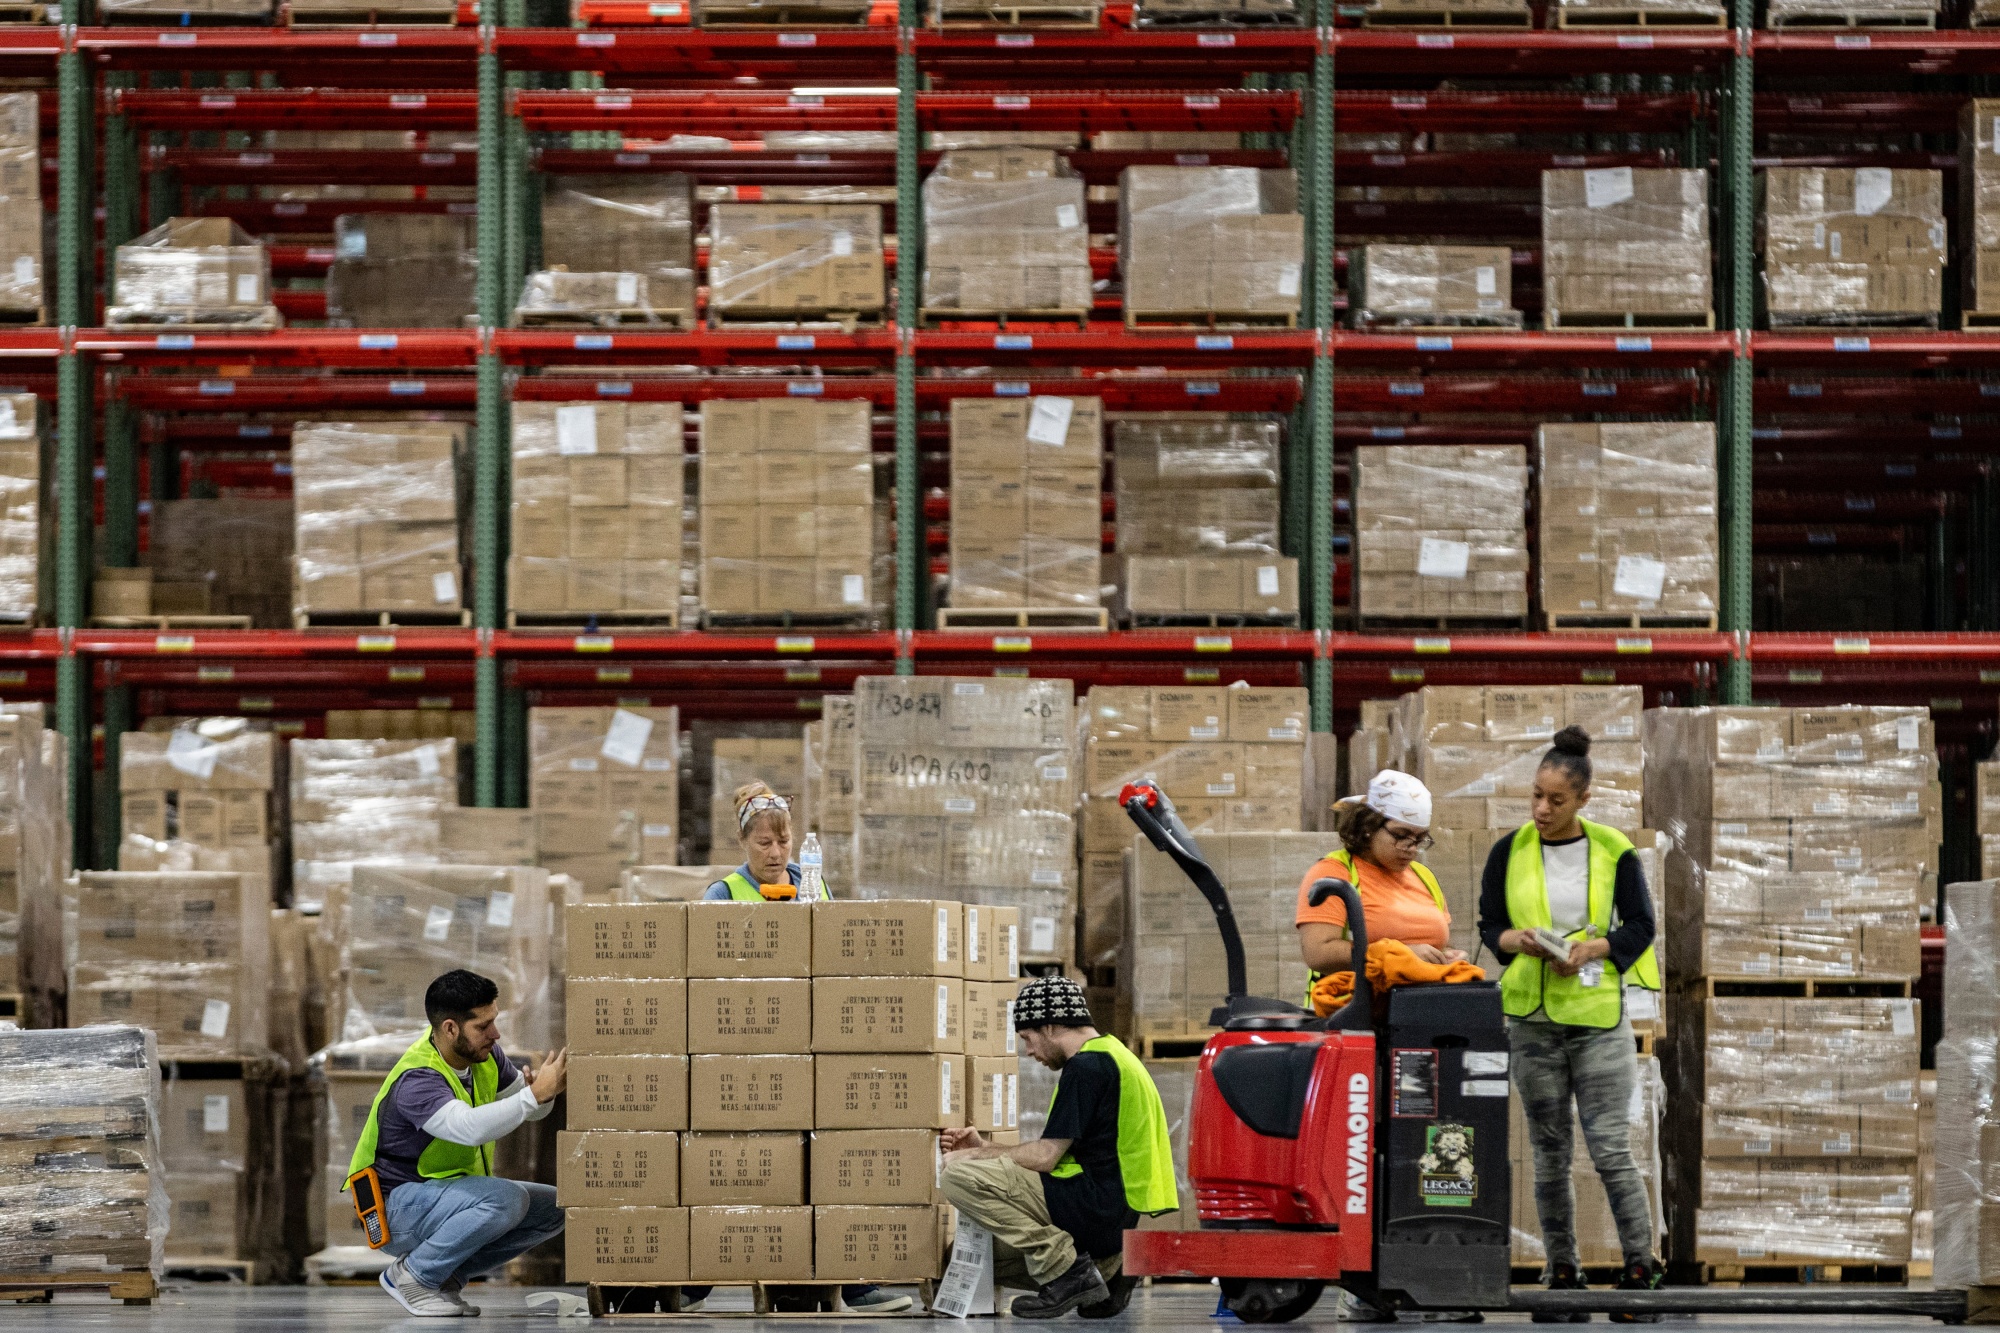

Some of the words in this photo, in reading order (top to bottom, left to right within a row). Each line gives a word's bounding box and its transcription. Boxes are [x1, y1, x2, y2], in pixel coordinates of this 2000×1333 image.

[625, 921, 631, 930] 6
[644, 921, 657, 930] PCS
[747, 921, 753, 929] 6
[766, 921, 779, 929] PCS
[644, 931, 657, 940] LBS
[766, 931, 779, 939] LBS
[842, 929, 854, 937] LBS
[644, 941, 657, 949] LBS
[766, 941, 779, 949] LBS
[842, 939, 854, 947] LBS
[841, 949, 854, 957] PCS
[626, 998, 632, 1006] 6
[645, 998, 658, 1006] PCS
[748, 997, 754, 1005] 6
[767, 997, 780, 1005] PCS
[645, 1008, 658, 1016] LBS
[767, 1007, 780, 1015] LBS
[842, 1006, 854, 1014] LBS
[767, 1017, 780, 1025] LBS
[842, 1016, 854, 1024] LBS
[841, 1026, 854, 1034] PCS
[626, 1074, 632, 1082] 6
[645, 1074, 658, 1082] PCS
[751, 1073, 757, 1081] 6
[770, 1073, 783, 1081] PCS
[645, 1084, 658, 1092] LBS
[770, 1083, 783, 1091] LBS
[846, 1082, 858, 1090] LBS
[645, 1094, 658, 1102] LBS
[770, 1093, 783, 1101] LBS
[846, 1092, 858, 1100] LBS
[845, 1102, 858, 1110] PCS
[1346, 1072, 1369, 1214] RAYMOND
[615, 1150, 621, 1158] 6
[634, 1150, 647, 1158] PCS
[740, 1149, 746, 1157] 6
[759, 1149, 772, 1157] PCS
[634, 1160, 647, 1168] LBS
[759, 1159, 772, 1167] LBS
[839, 1159, 851, 1167] LBS
[634, 1170, 647, 1178] LBS
[759, 1169, 772, 1177] LBS
[839, 1169, 851, 1177] LBS
[838, 1179, 851, 1187] PCS
[1423, 1179, 1476, 1190] LEGACY
[626, 1226, 632, 1234] 6
[645, 1226, 658, 1234] PCS
[645, 1236, 658, 1244] LBS
[721, 1235, 733, 1243] LBS
[846, 1234, 858, 1242] LBS
[645, 1246, 658, 1254] LBS
[721, 1245, 733, 1253] LBS
[846, 1244, 858, 1252] LBS
[720, 1255, 733, 1263] PCS
[845, 1253, 858, 1261] PCS
